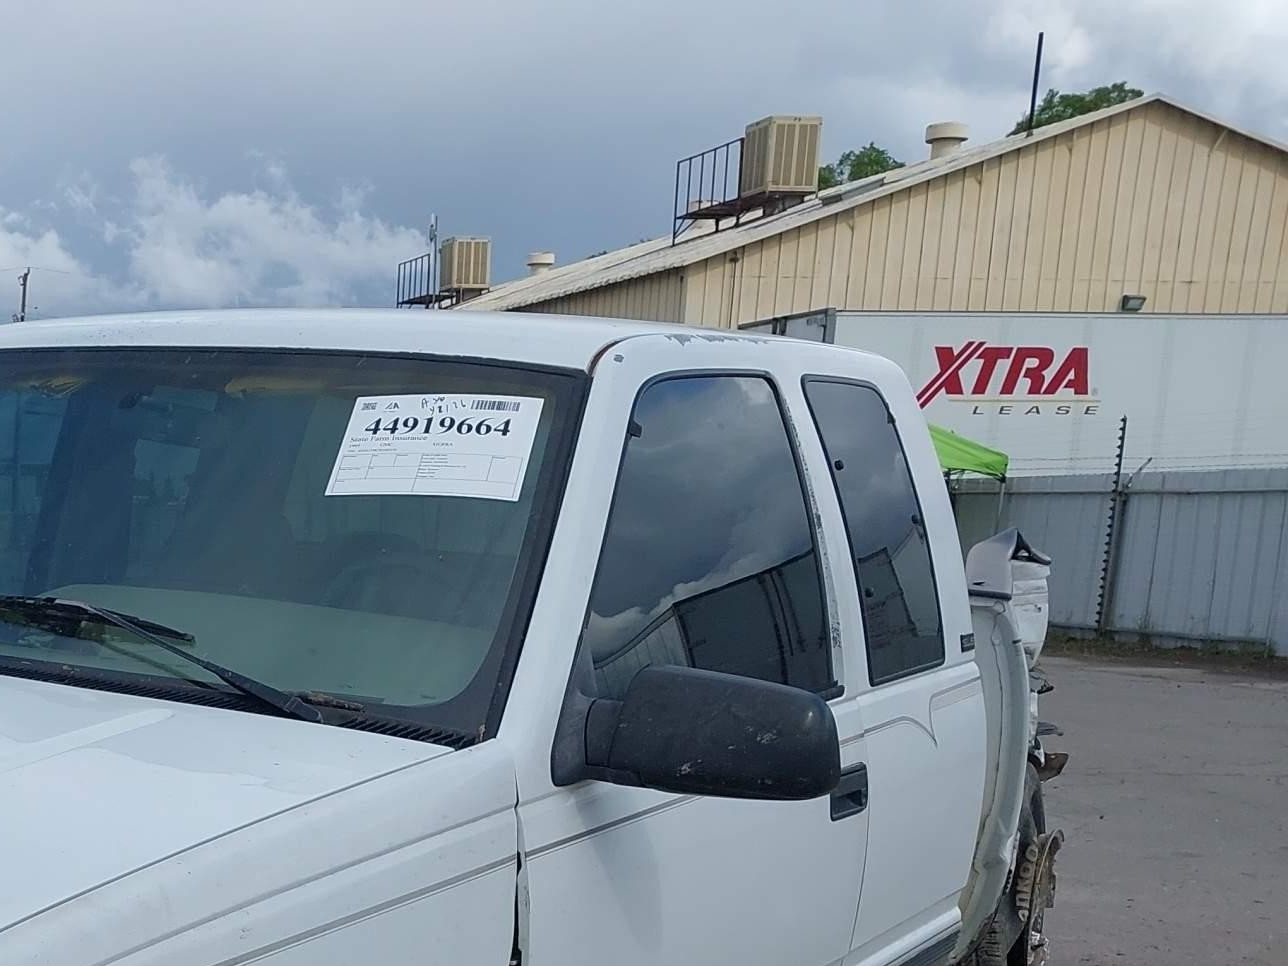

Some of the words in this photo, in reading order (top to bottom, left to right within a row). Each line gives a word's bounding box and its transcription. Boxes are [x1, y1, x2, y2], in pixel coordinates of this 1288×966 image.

[916, 341, 1089, 409] XTRA
[972, 405, 1100, 415] LEASE
[364, 416, 512, 437] 44919664
